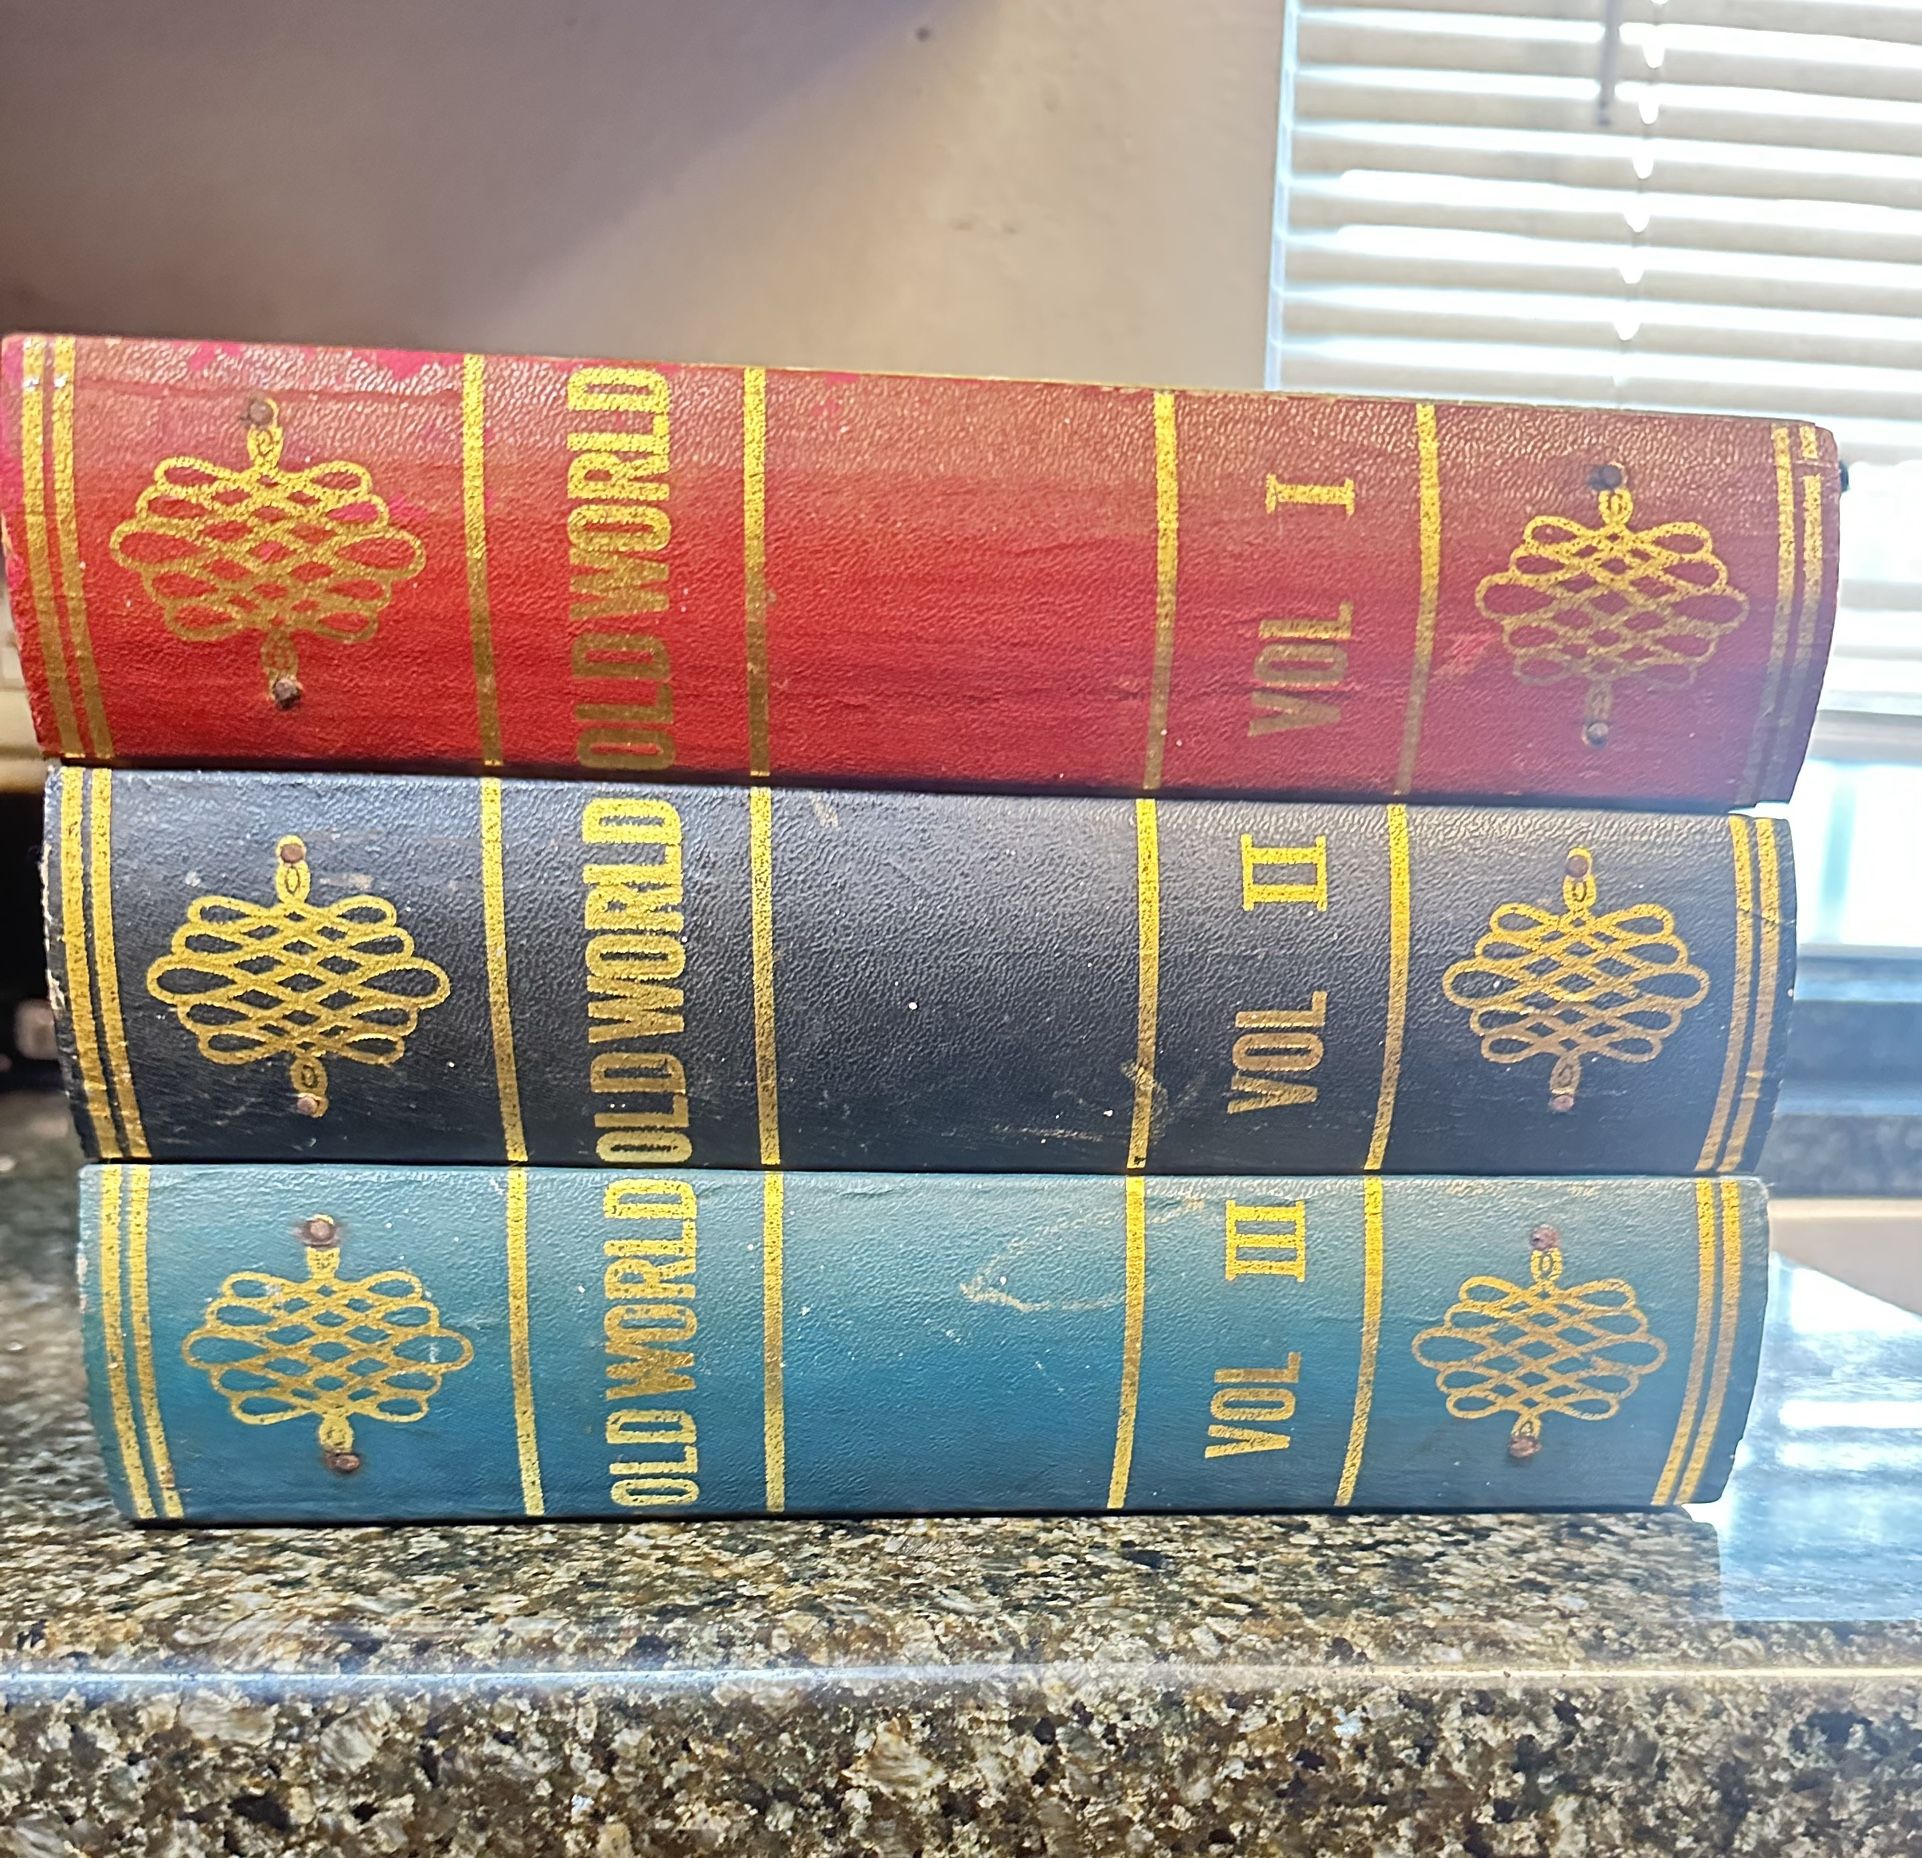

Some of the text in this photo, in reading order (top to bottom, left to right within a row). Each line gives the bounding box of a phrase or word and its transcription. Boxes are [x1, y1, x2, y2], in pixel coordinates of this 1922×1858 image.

[567, 367, 676, 770] OLD WORLD
[1248, 473, 1355, 737] VOL I
[582, 798, 693, 1163] OLD WORLD
[1227, 833, 1328, 1124] VOL II
[603, 1178, 699, 1506] OLD WORLD
[1204, 1200, 1306, 1459] VOL III
